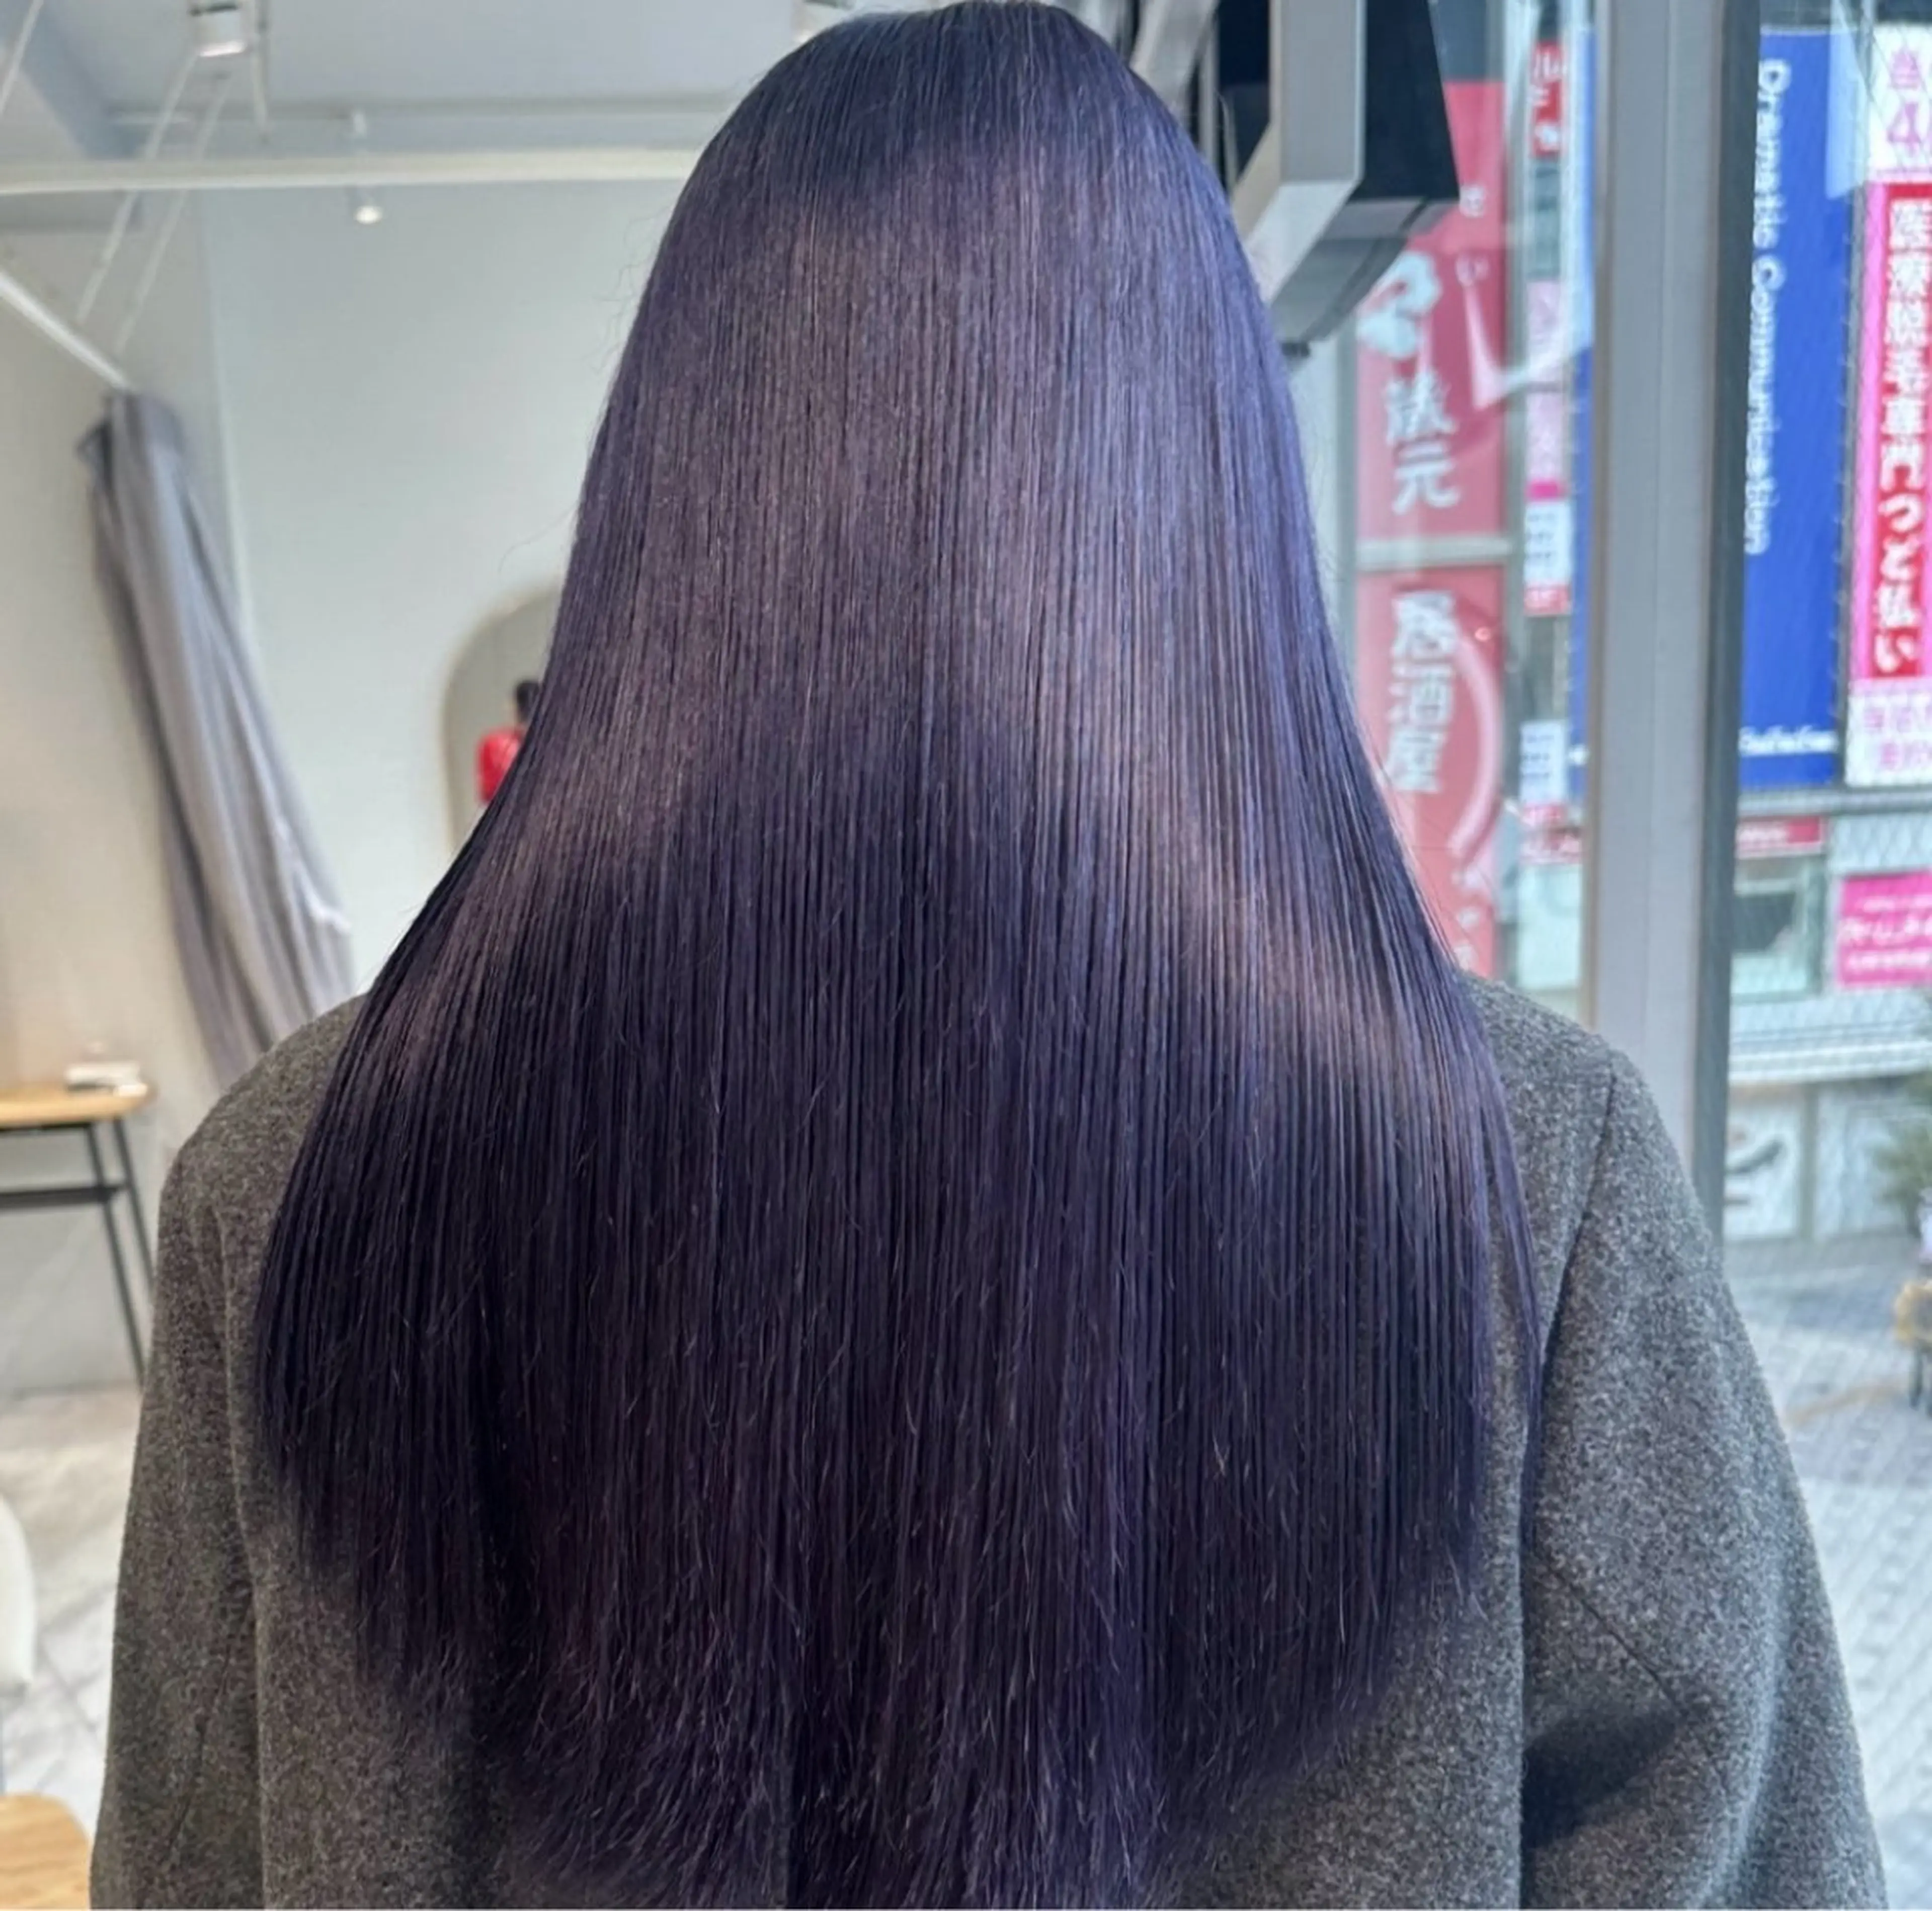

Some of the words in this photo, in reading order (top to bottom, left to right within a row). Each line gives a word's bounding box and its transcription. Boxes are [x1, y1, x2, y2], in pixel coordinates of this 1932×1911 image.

[1752, 57, 1792, 250] Dramatic
[1743, 254, 1787, 554] Communication
[1387, 591, 1454, 793] 居酒屋
